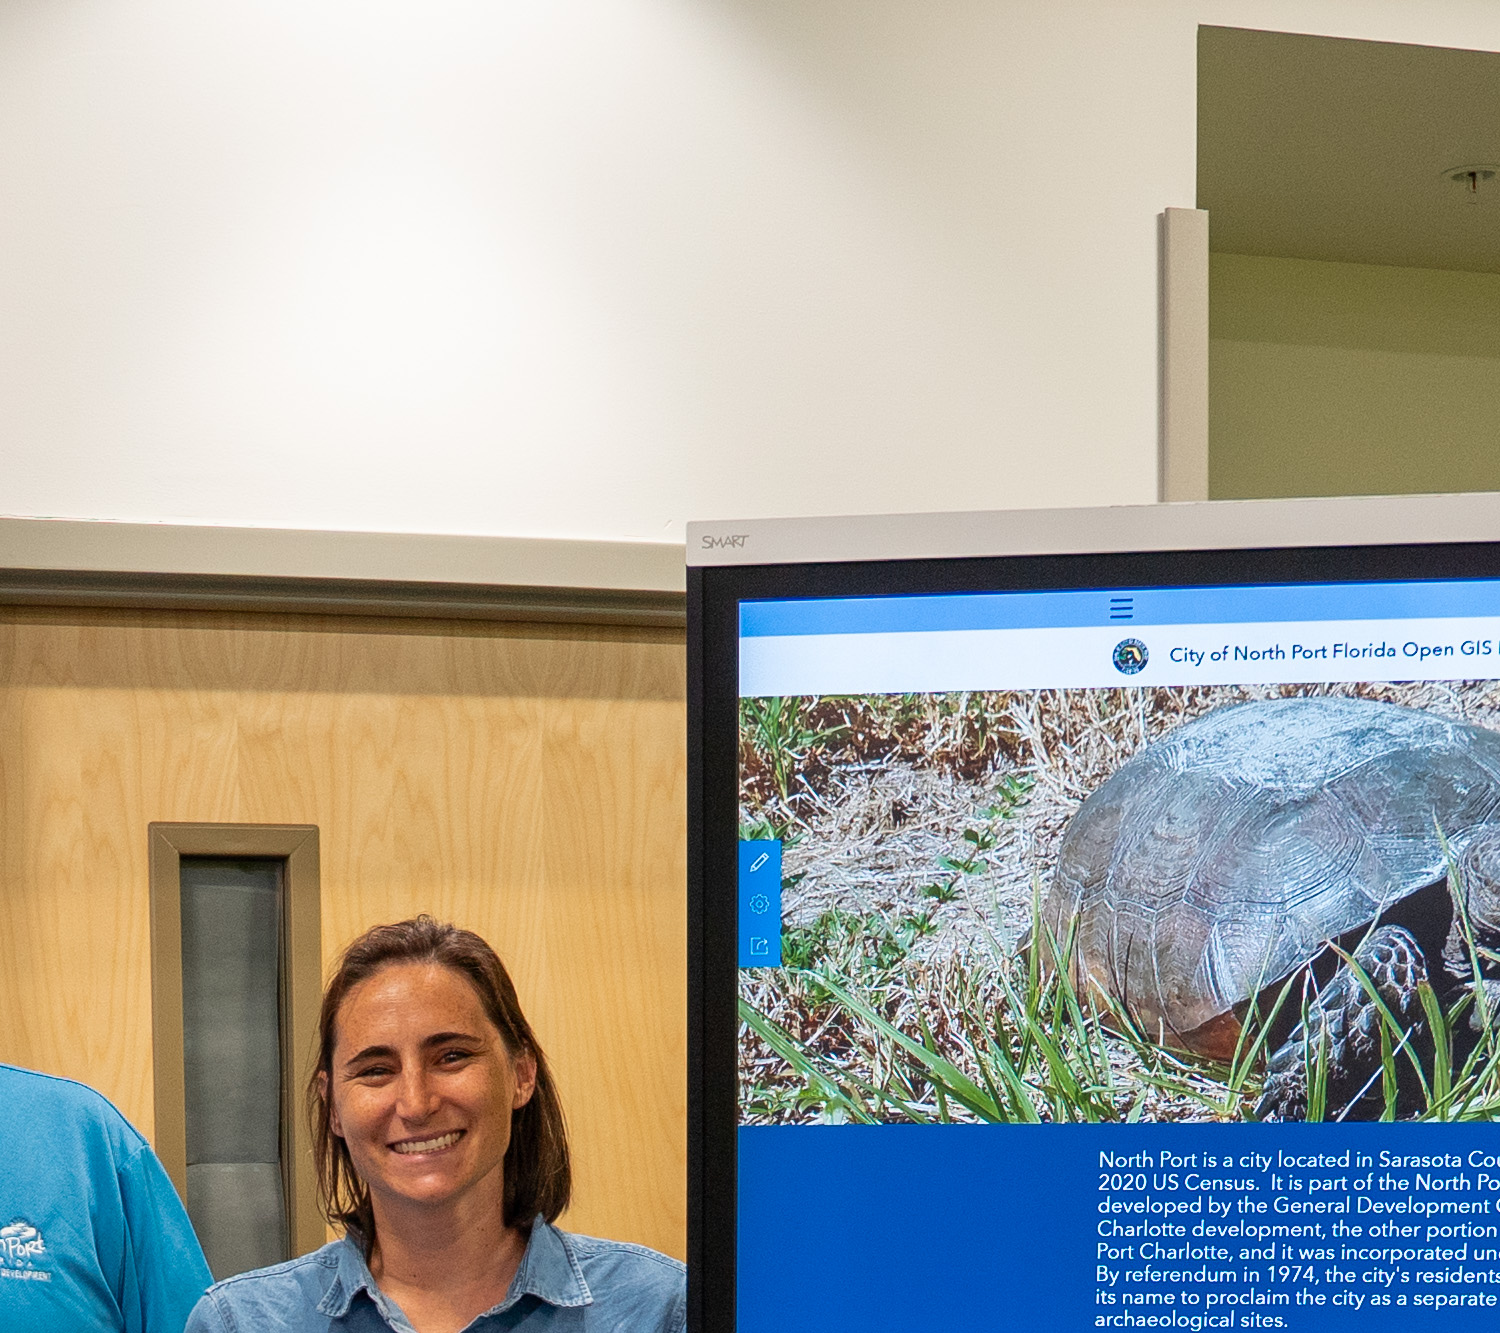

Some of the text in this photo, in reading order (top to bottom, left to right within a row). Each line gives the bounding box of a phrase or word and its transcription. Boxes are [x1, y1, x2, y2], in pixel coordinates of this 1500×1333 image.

[701, 534, 750, 550] SMART
[1169, 647, 1206, 668] City
[1209, 645, 1230, 662] of
[1234, 643, 1286, 661] North
[1291, 643, 1328, 660] Port
[1332, 640, 1397, 659] Florida
[1402, 640, 1454, 662] Open
[1460, 639, 1492, 656] GIS
[1099, 1149, 1154, 1168] North
[1160, 1150, 1198, 1169] Port
[1202, 1150, 1218, 1168] is
[1222, 1155, 1233, 1168] a
[1239, 1151, 1272, 1172] city
[1278, 1149, 1350, 1168] located
[1356, 1151, 1373, 1168] in
[1378, 1150, 1462, 1168] Sarasota
[1098, 1173, 1147, 1191] 2020
[1153, 1173, 1179, 1191] US
[1184, 1172, 1260, 1191] Census.
[1271, 1173, 1284, 1192] It
[1288, 1174, 1303, 1191] is
[1308, 1176, 1348, 1195] part
[1353, 1172, 1374, 1191] of
[1378, 1172, 1410, 1191] the
[1415, 1172, 1471, 1191] North
[1097, 1195, 1202, 1217] developed
[1208, 1195, 1232, 1217] by
[1237, 1195, 1268, 1214] the
[1273, 1195, 1350, 1214] General
[1357, 1195, 1490, 1218] Development
[1097, 1216, 1187, 1237] Charlotte
[1191, 1219, 1326, 1242] development,
[1331, 1219, 1363, 1238] the
[1368, 1219, 1422, 1238] other
[1426, 1221, 1498, 1242] portion
[1097, 1242, 1134, 1260] Port
[1139, 1241, 1233, 1262] Charlotte,
[1238, 1240, 1276, 1261] and
[1281, 1243, 1294, 1261] it
[1298, 1248, 1336, 1261] was
[1341, 1240, 1468, 1265] incorporated
